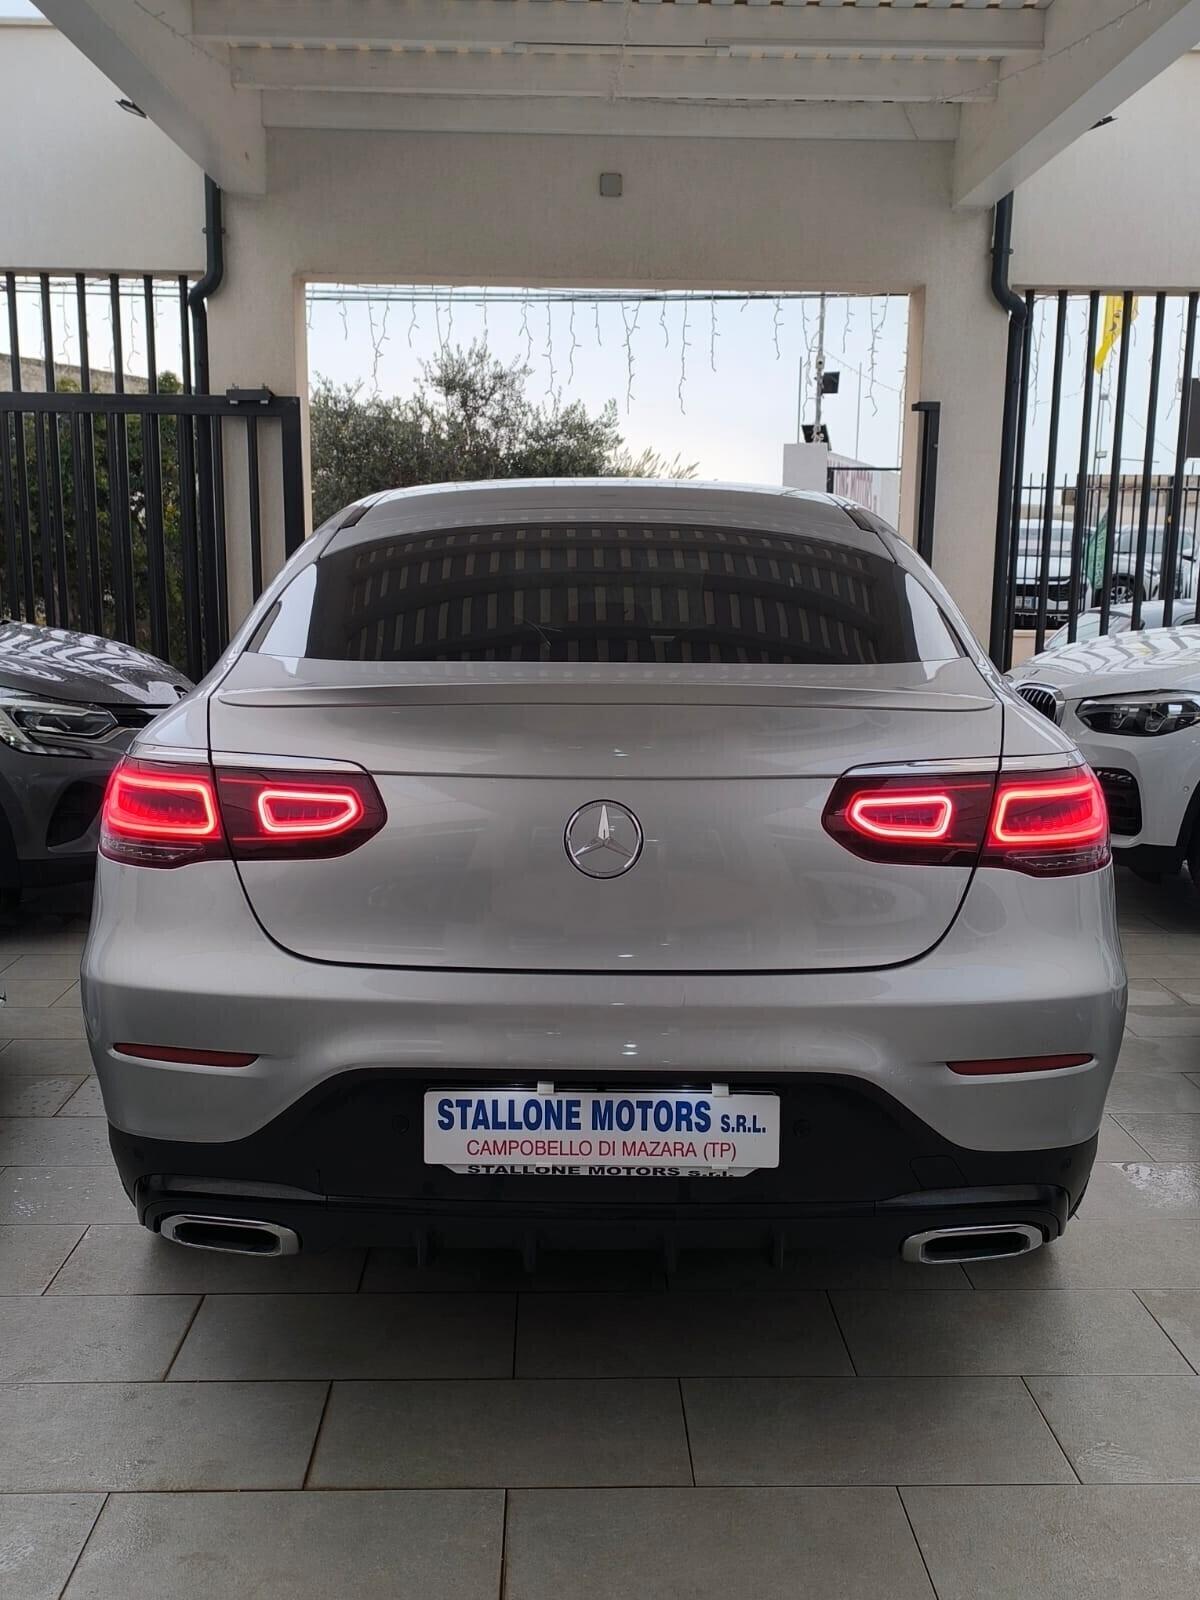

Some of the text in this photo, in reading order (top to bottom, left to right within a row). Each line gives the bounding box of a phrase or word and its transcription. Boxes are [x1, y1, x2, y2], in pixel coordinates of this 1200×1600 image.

[437, 1099, 767, 1133] STALLONE MOTORS S.R.L.
[466, 1139, 737, 1161] CAMPOBELLO DI MAZARA (TP)
[467, 1165, 581, 1175] STALLONE
[588, 1166, 681, 1176] MOTORS
